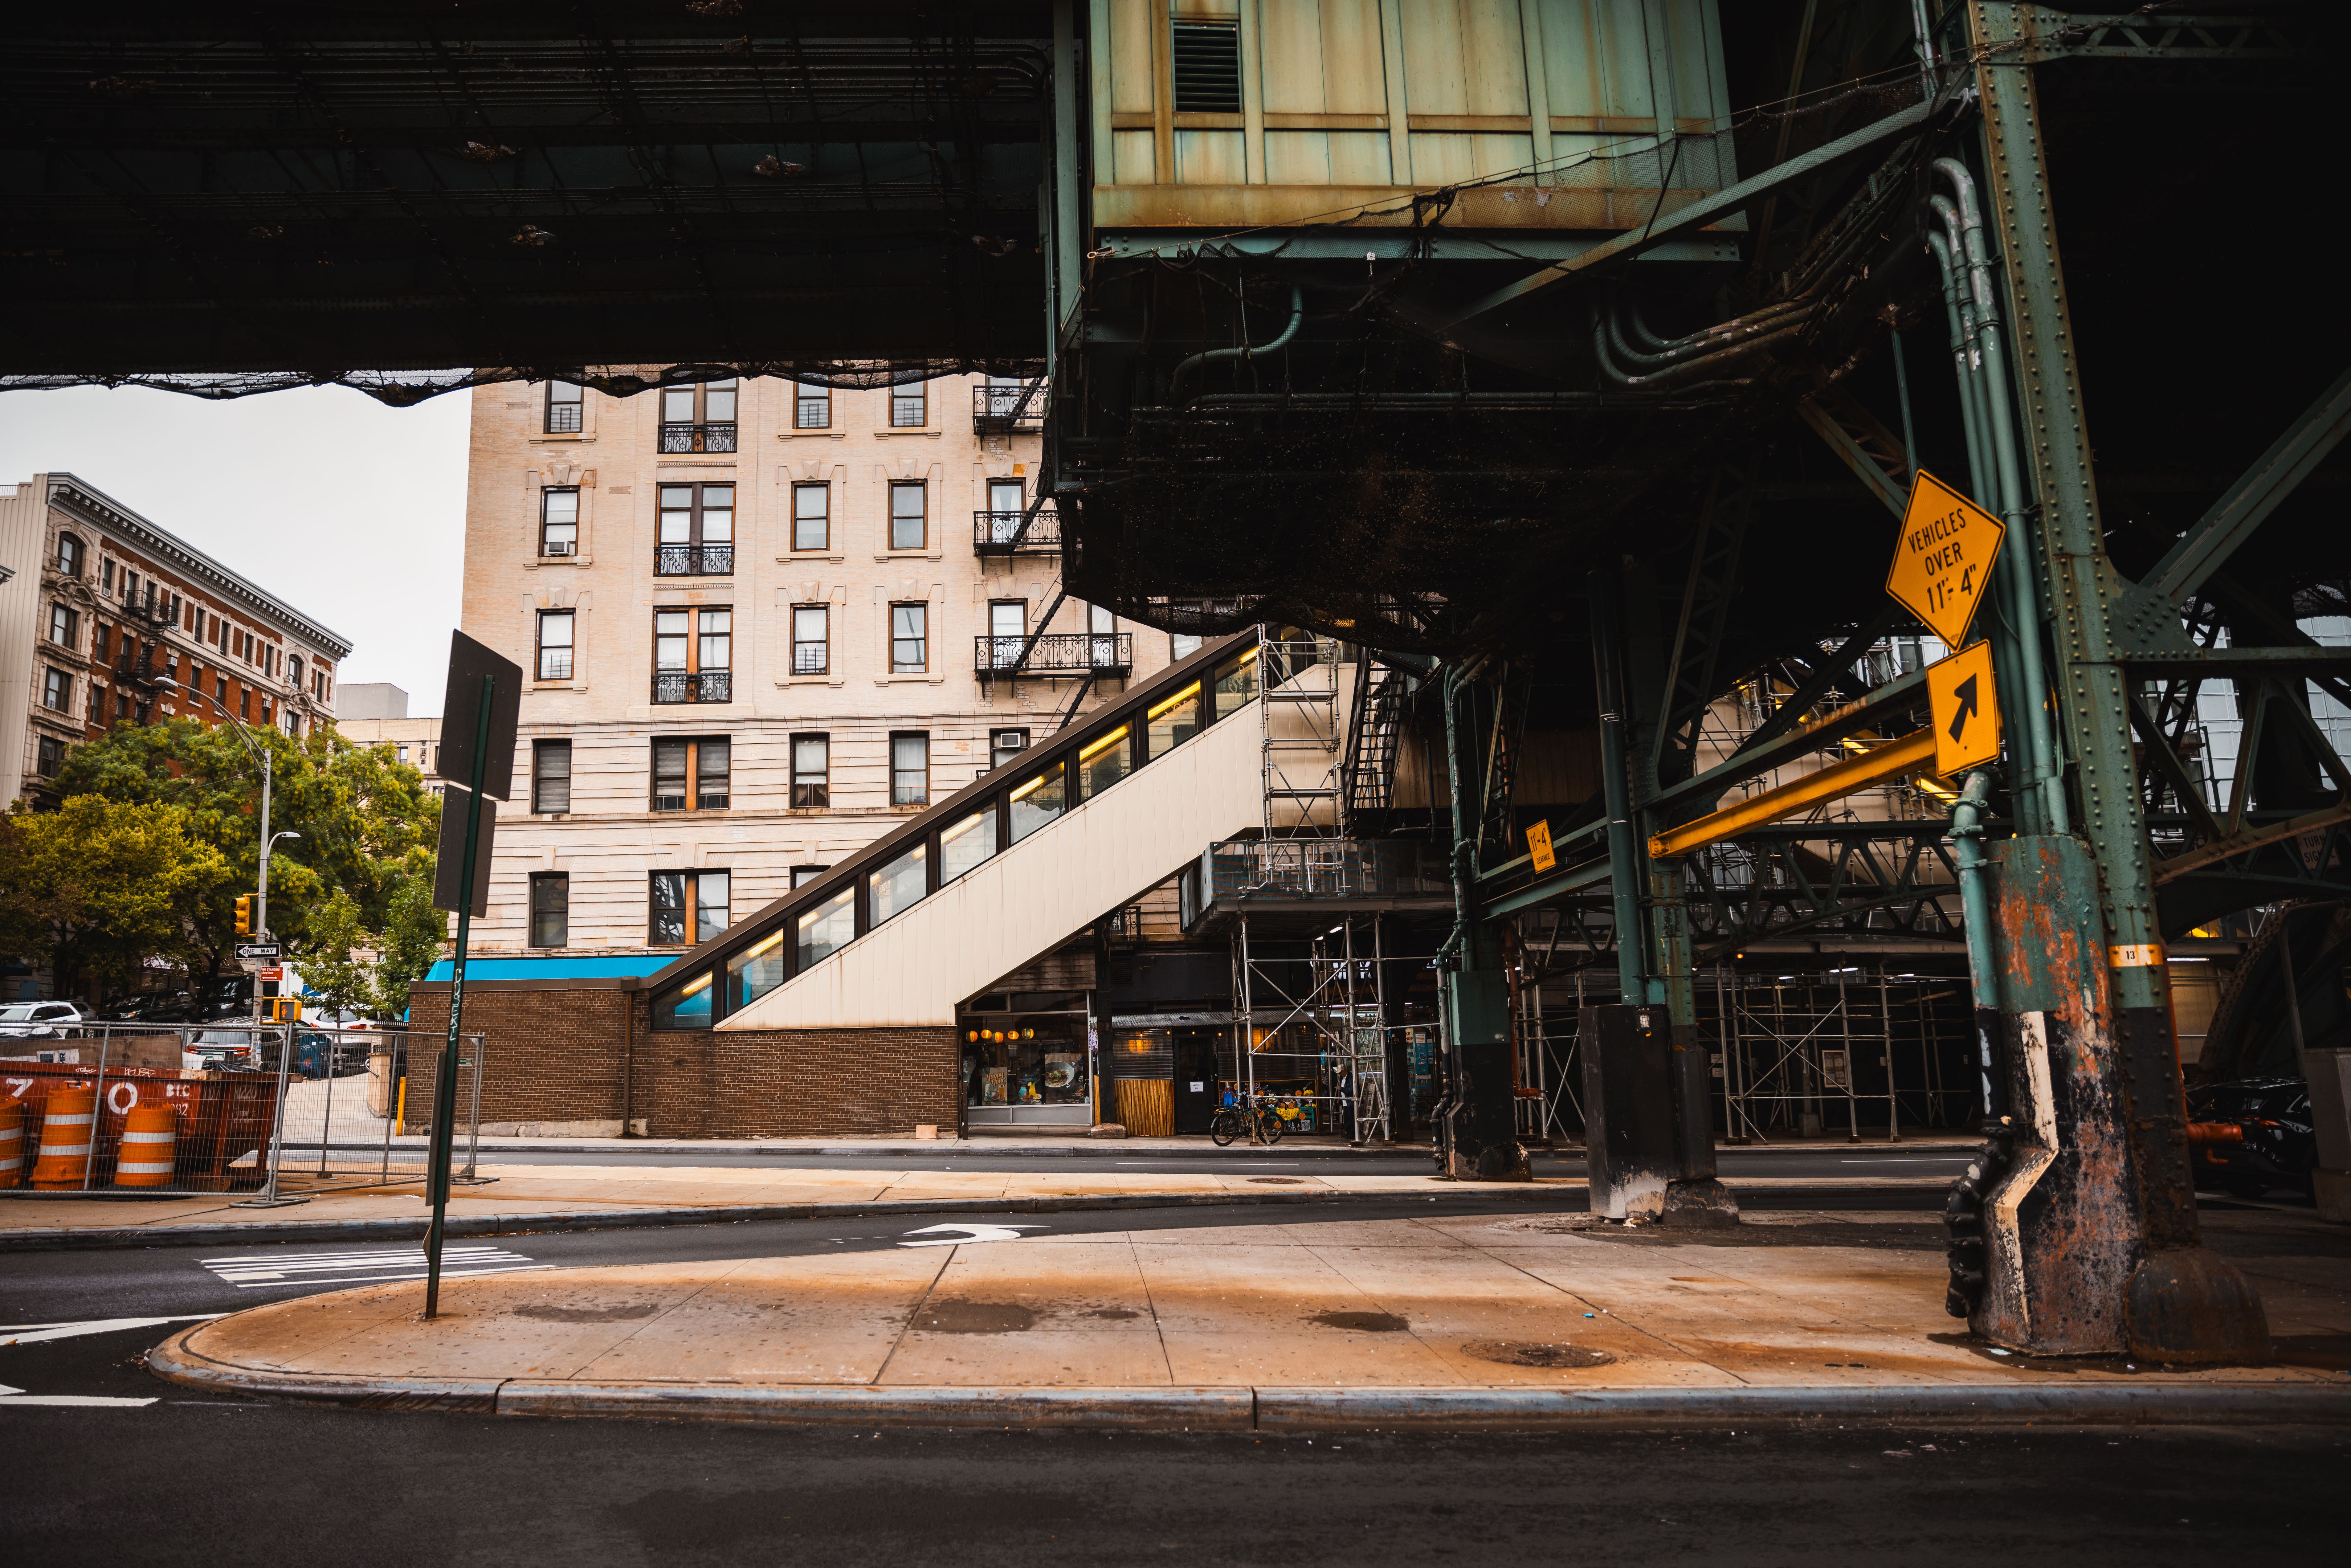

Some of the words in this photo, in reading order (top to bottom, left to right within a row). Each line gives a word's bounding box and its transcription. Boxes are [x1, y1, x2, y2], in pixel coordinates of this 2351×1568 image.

[1908, 508, 1966, 554] VEHICLES
[1925, 542, 1963, 576] OVER
[2303, 834, 2326, 848] TURN
[1536, 853, 1550, 865] CLEARANCE
[2126, 951, 2135, 960] 13
[985, 1072, 1004, 1081] Happy
